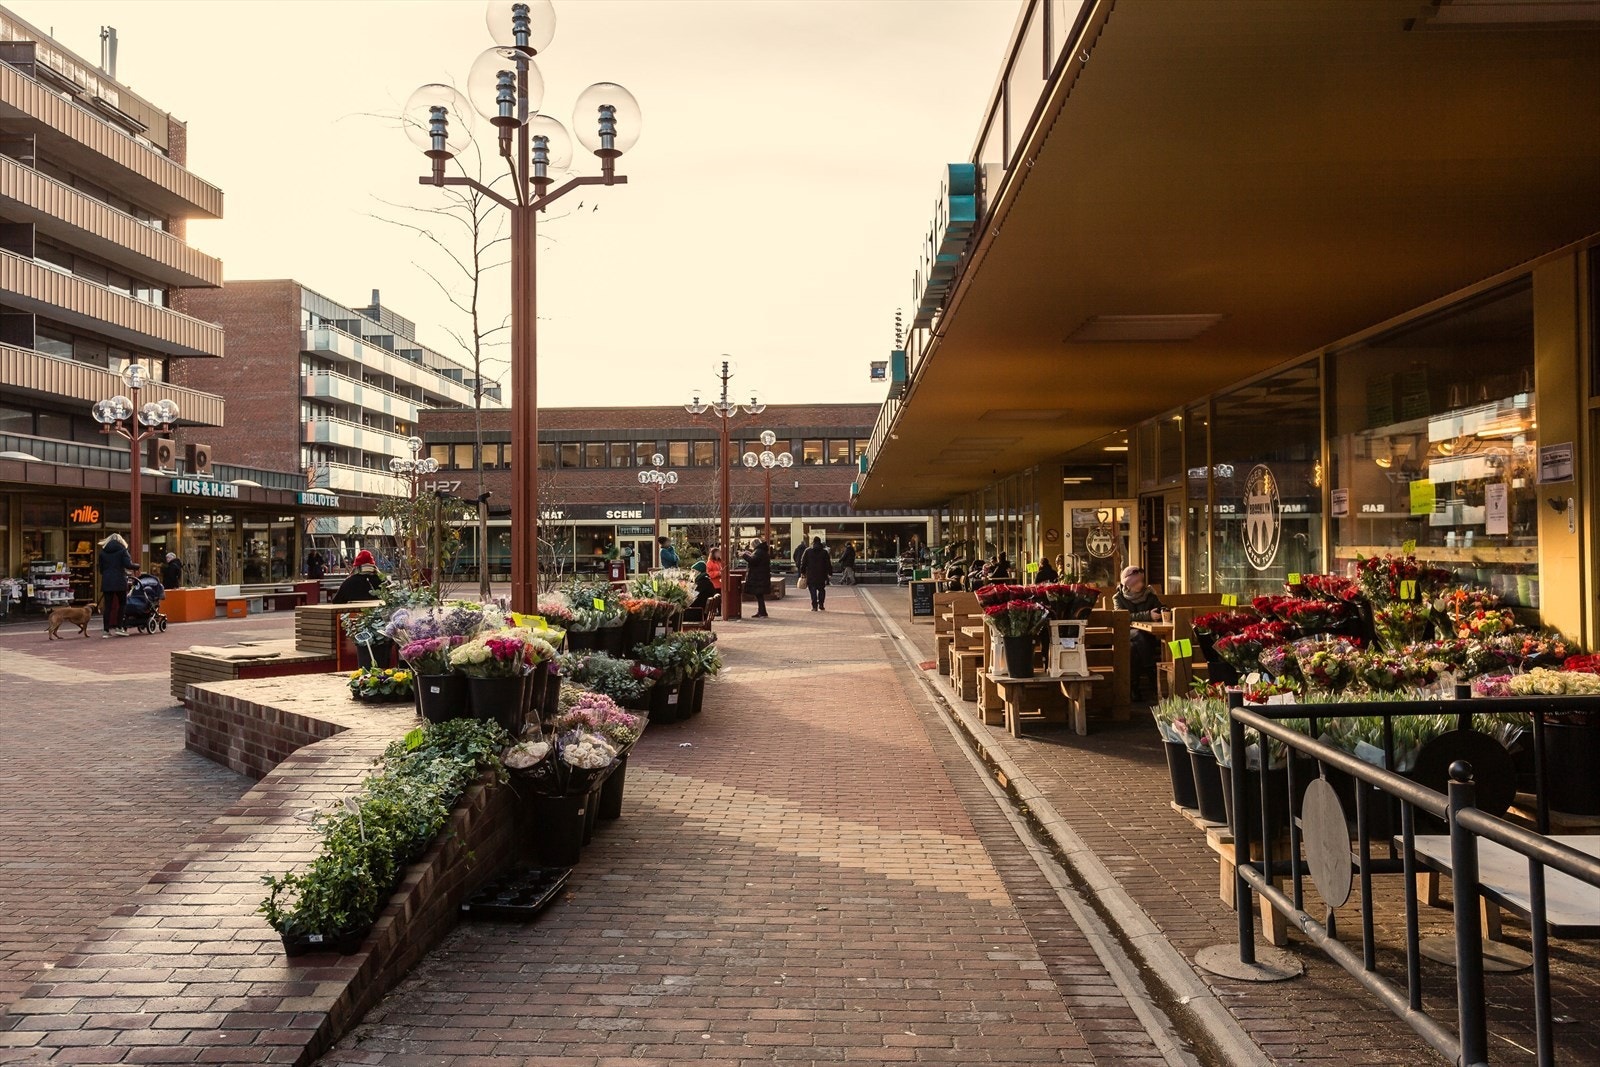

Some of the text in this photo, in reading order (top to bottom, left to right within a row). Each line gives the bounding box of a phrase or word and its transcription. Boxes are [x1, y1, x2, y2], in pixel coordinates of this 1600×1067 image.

[177, 479, 239, 498] HUS & HJEM
[424, 481, 461, 492] H27
[302, 492, 339, 508] BIBLIOTEK
[73, 505, 99, 523] nille
